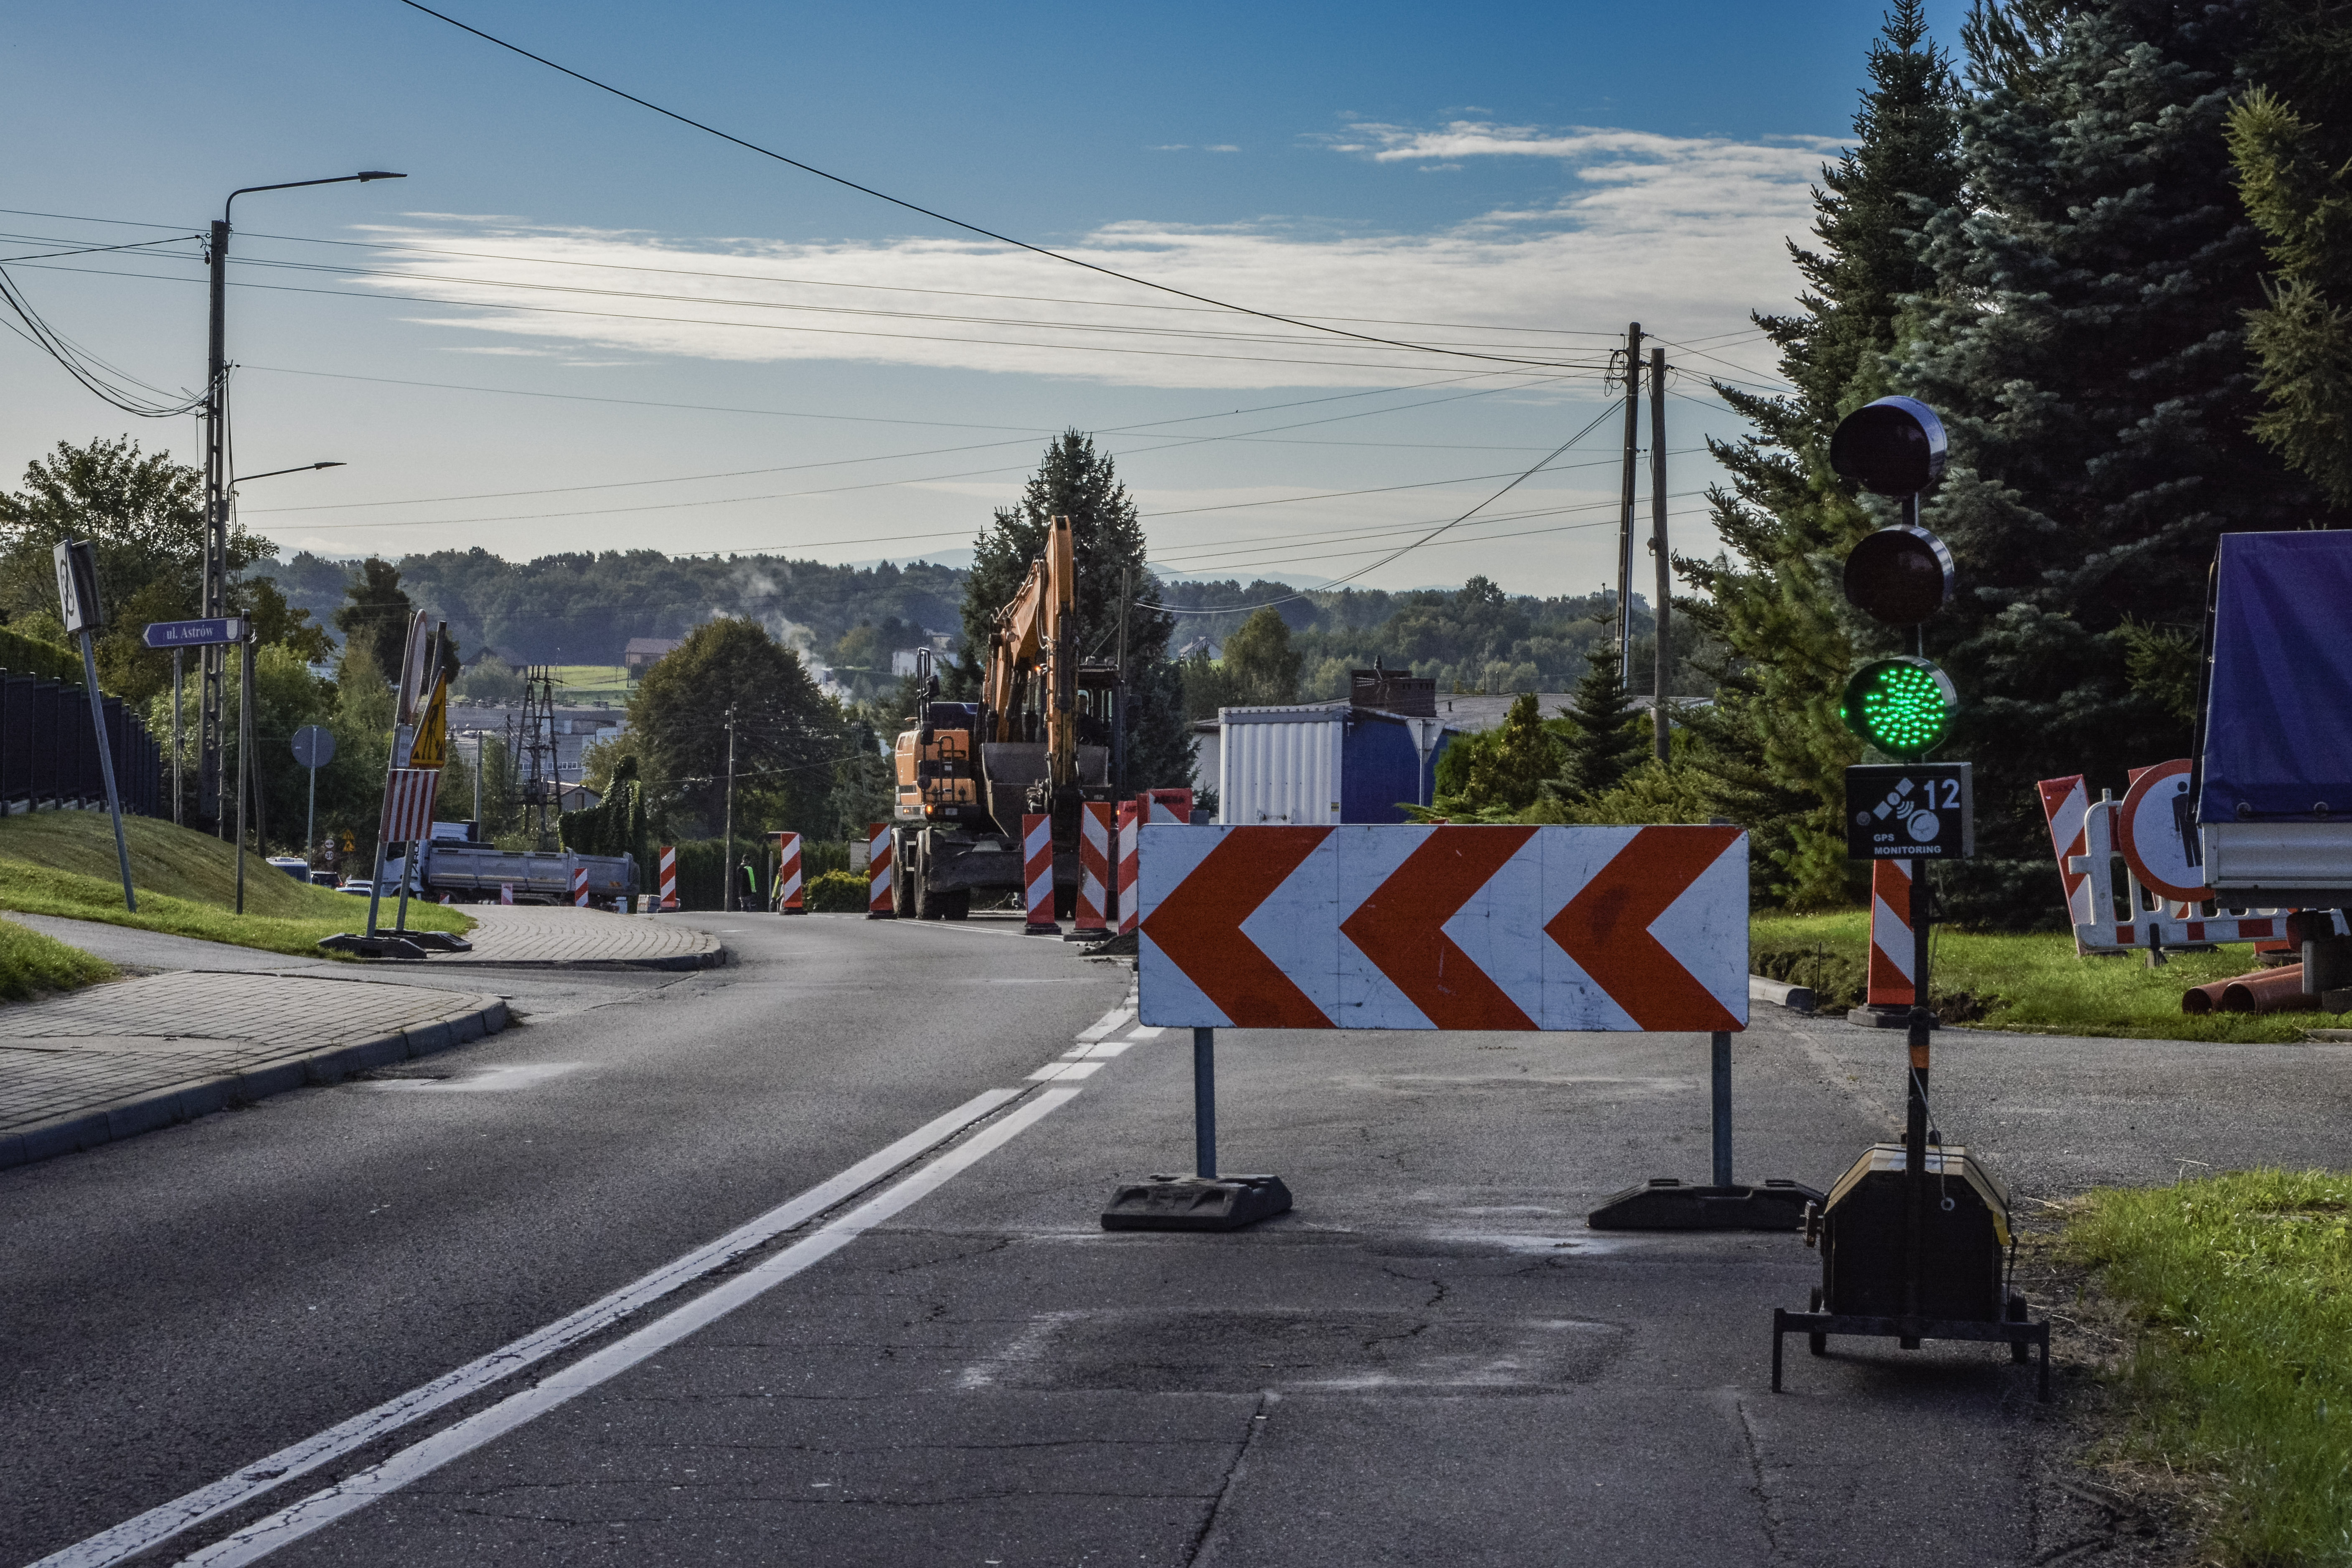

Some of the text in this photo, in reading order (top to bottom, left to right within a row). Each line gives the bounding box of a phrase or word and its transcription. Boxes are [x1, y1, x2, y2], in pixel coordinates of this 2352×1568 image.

[167, 625, 213, 639] ul. Astrów
[1924, 779, 1960, 810] 12
[1874, 846, 1941, 854] MONITORING
